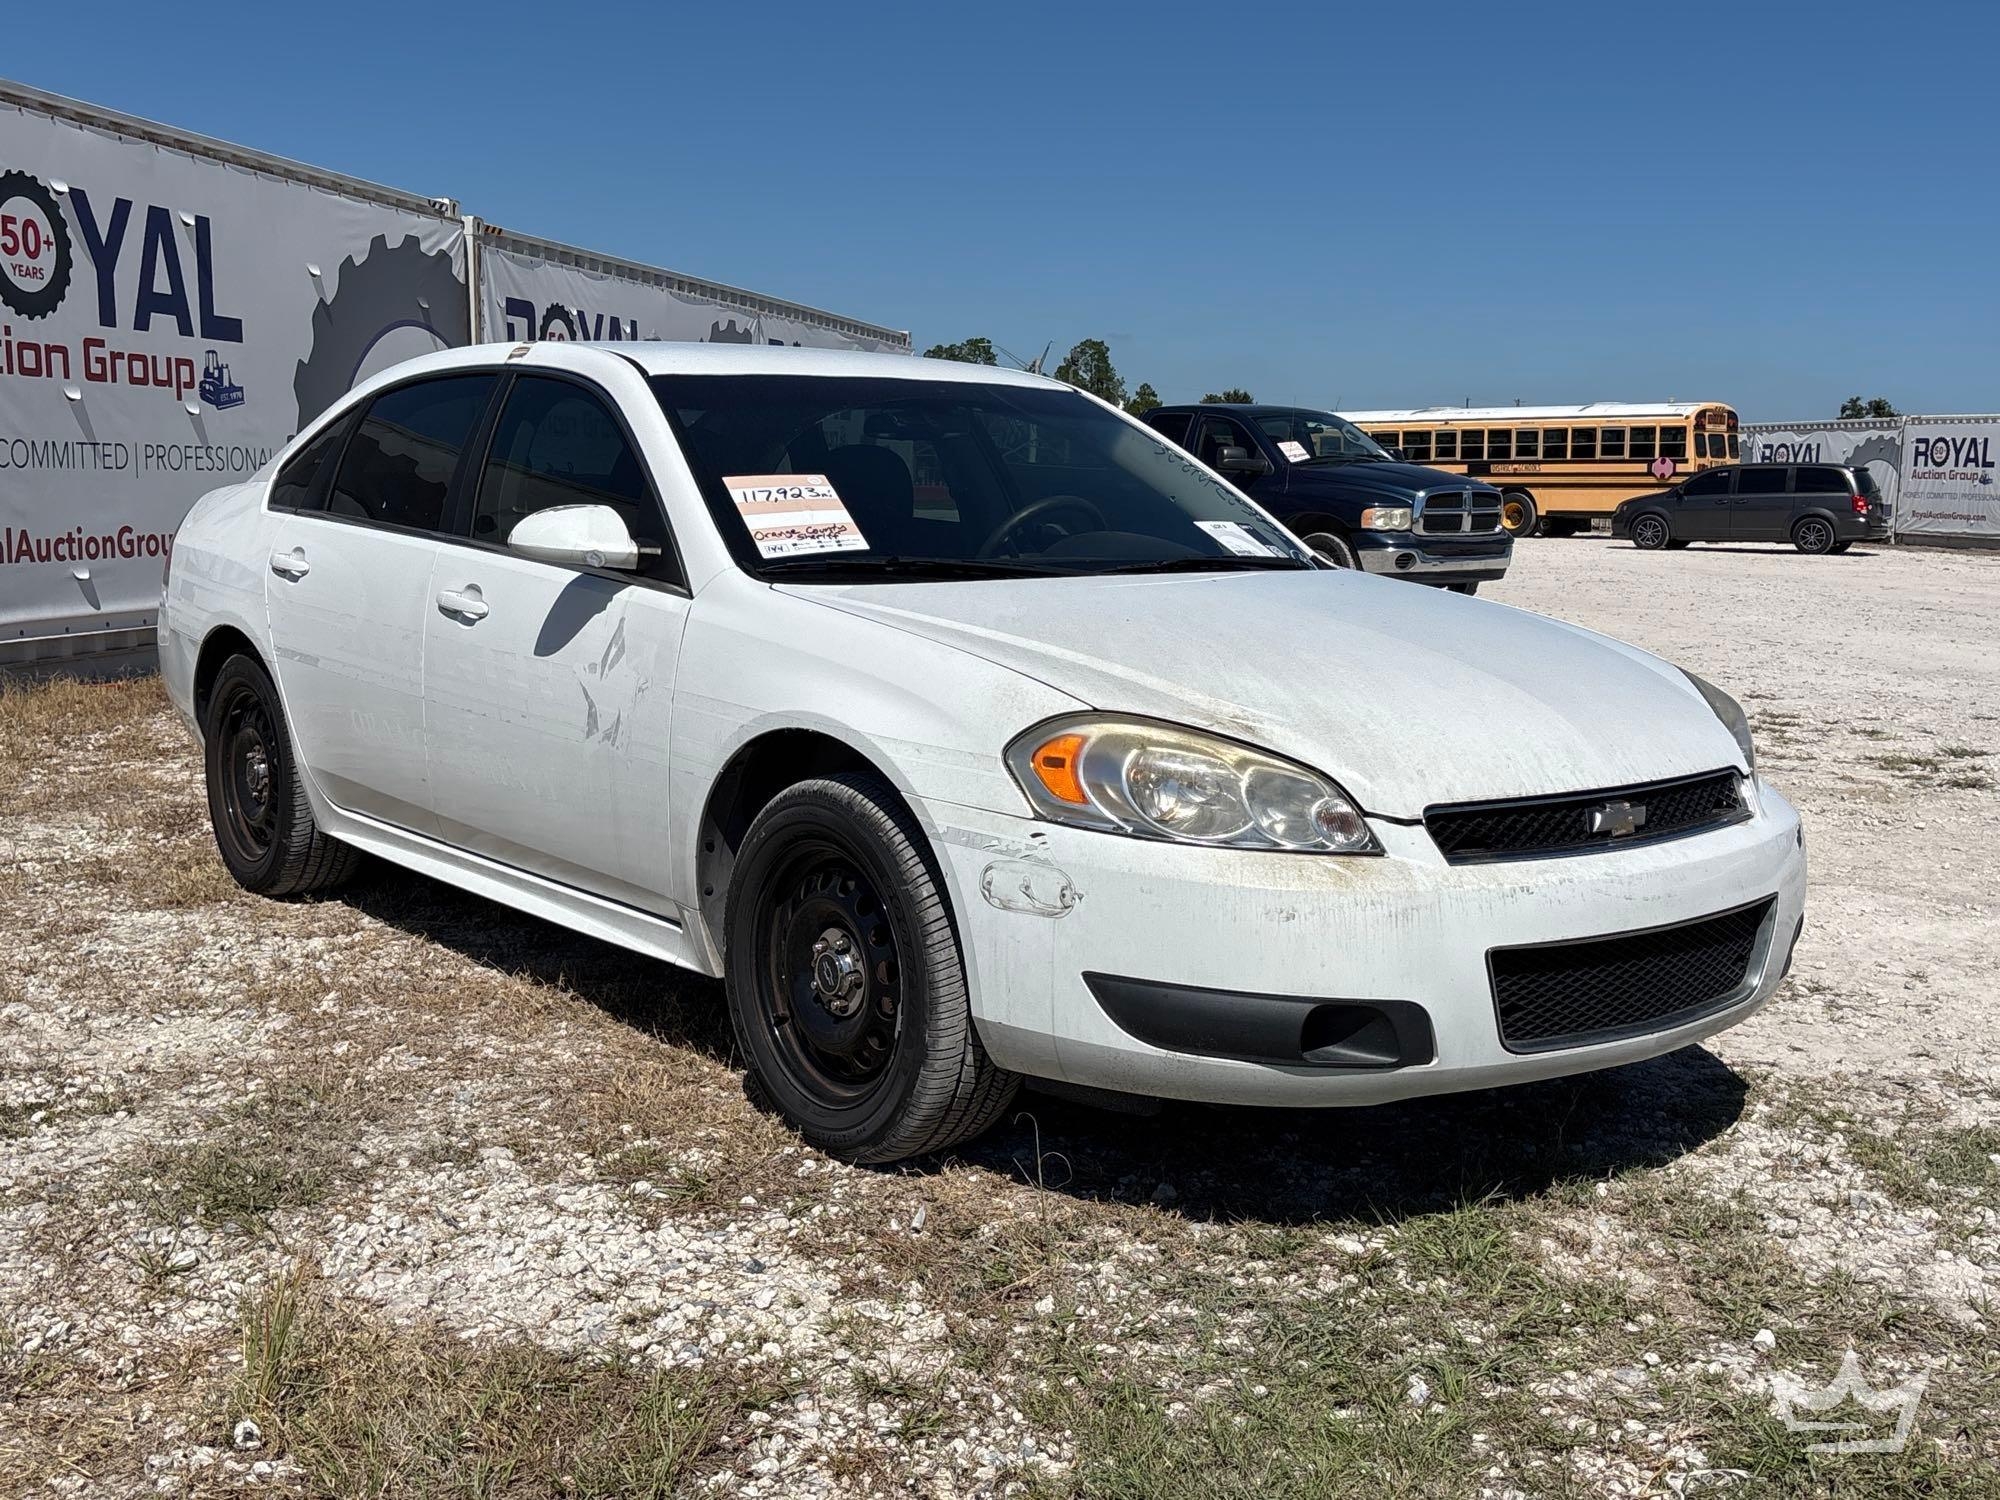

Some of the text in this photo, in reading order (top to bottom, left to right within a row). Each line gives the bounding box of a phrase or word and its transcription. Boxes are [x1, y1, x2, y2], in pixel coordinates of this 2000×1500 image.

[1, 215, 54, 259] 50+
[0, 168, 244, 342] OYAL
[10, 262, 45, 280] YEARS
[0, 325, 196, 400] ion Group
[1913, 436, 1995, 468] ROYAL
[1911, 469, 1979, 483] Auction Group
[742, 487, 820, 503] 117,923
[1911, 510, 1987, 523] RoyalAuctionGroup.com
[754, 523, 847, 541] Orange County
[0, 526, 173, 564] lAuctionGrou
